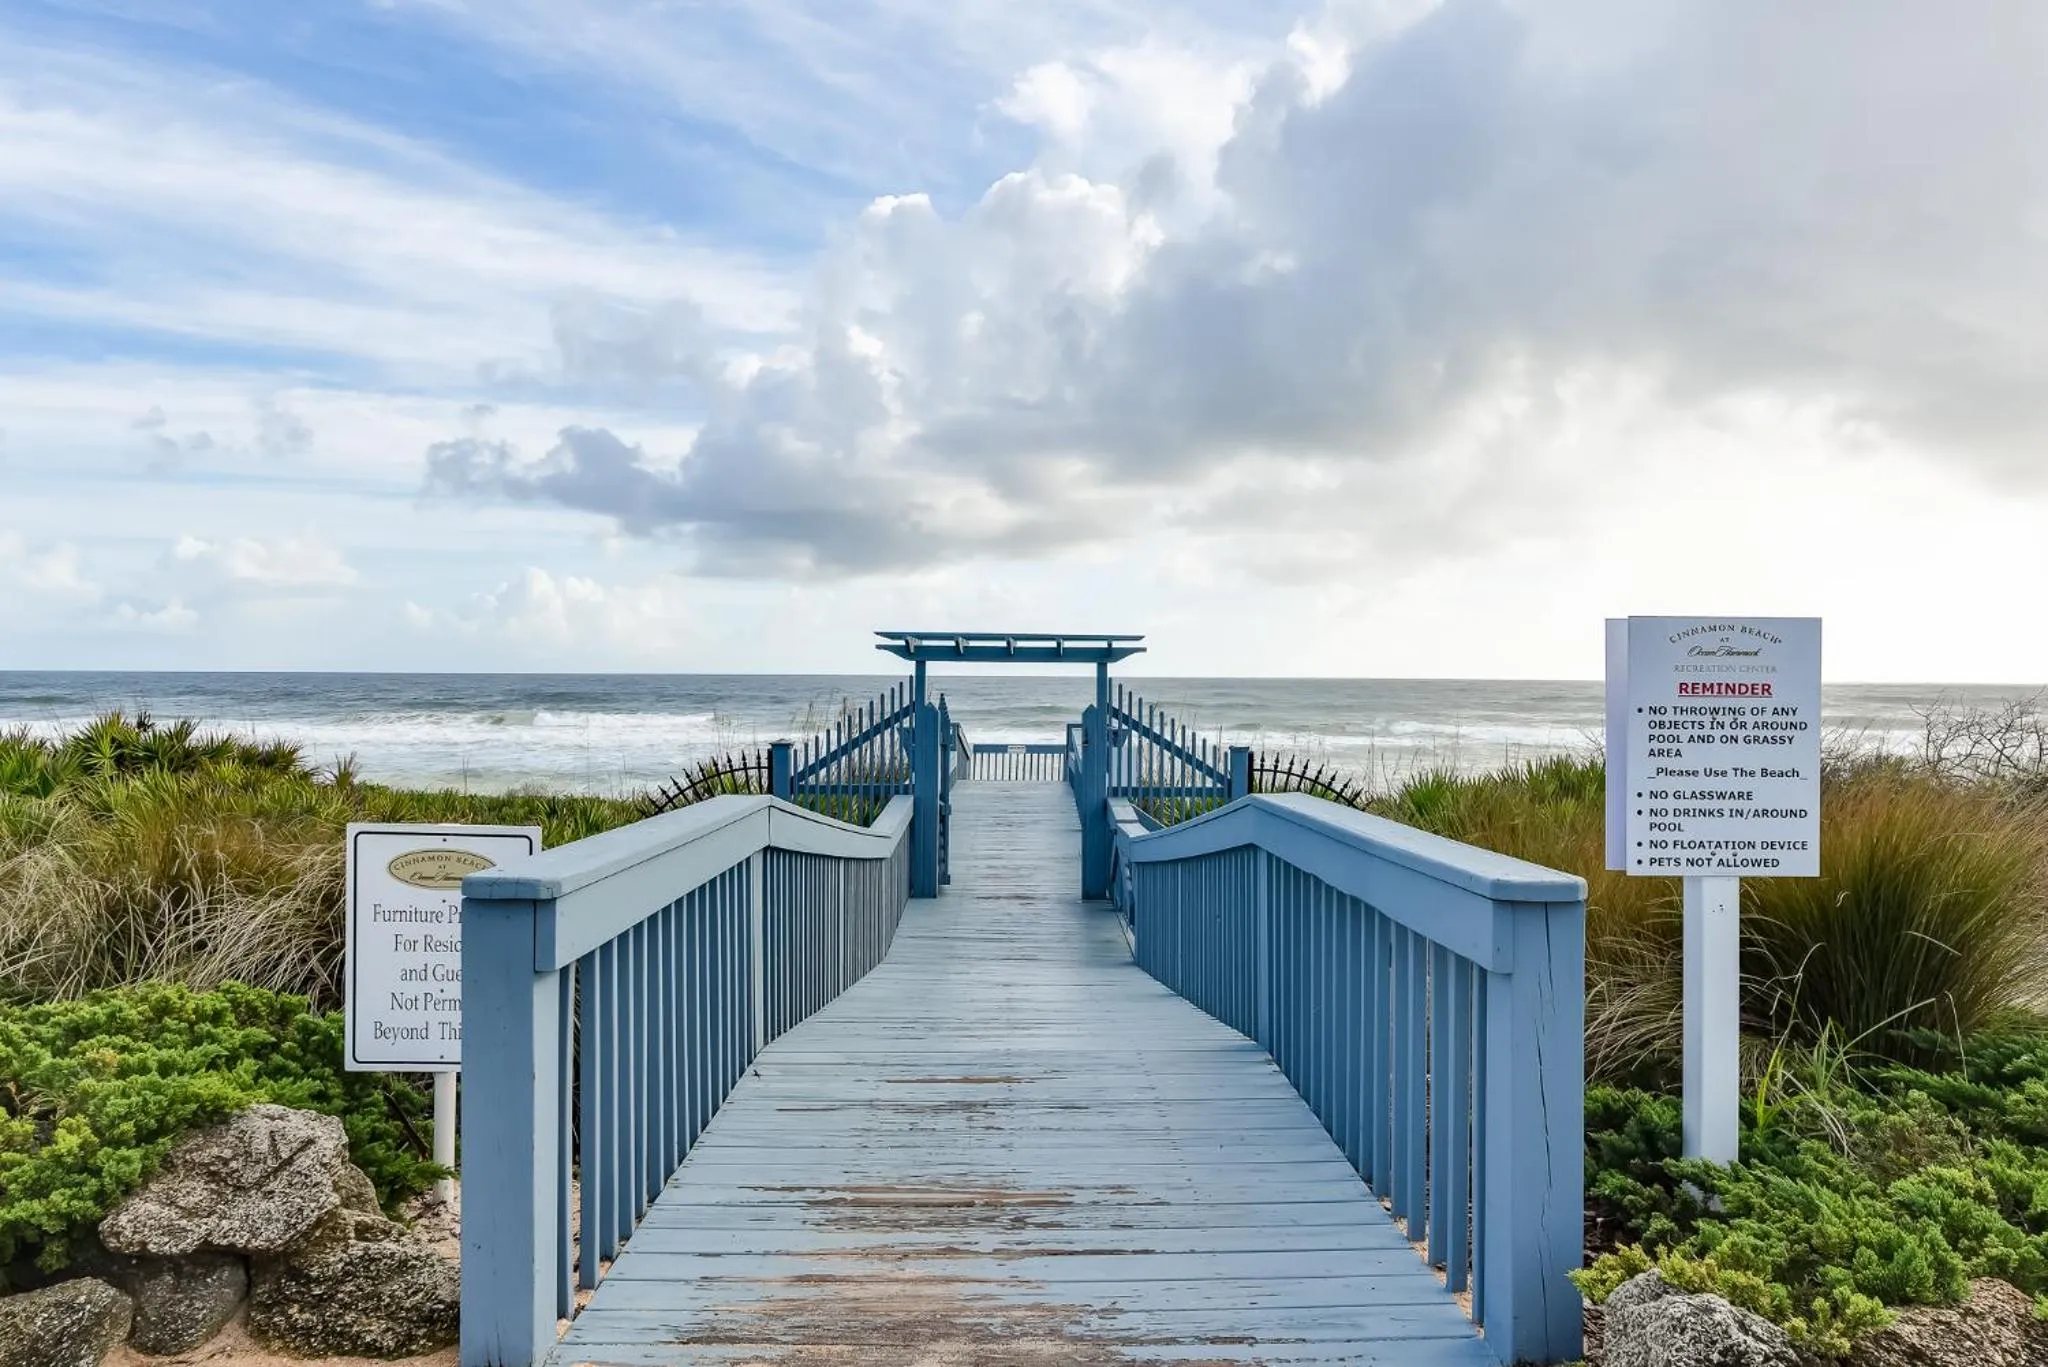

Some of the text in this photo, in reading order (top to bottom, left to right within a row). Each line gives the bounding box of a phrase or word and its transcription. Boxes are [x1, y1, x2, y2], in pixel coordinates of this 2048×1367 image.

[1669, 624, 1735, 643] CINNAMON
[1673, 664, 1777, 673] RECREATION CENTER
[1678, 682, 1773, 697] REMINDER
[1648, 705, 1799, 717] NO THROWING OF ANY
[1648, 720, 1808, 731] OBJECTS IN OR AROUND
[1648, 734, 1795, 745] POOL AND ON GRASSY
[1648, 748, 1683, 758] AREA
[1703, 767, 1728, 778] Use
[1732, 767, 1756, 778] The
[1649, 790, 1754, 801] NO GLASSWARE
[1649, 807, 1808, 819] NO DRINKS IN/AROUND
[1649, 822, 1684, 832] POOL
[1649, 839, 1808, 851] NO FLOATATION DEVICE
[393, 855, 451, 870] CINNAMON
[1649, 857, 1780, 868] PETS NOT ALLOWED
[373, 903, 444, 924] Furniture
[393, 933, 419, 952] For
[400, 963, 428, 981] and
[390, 992, 419, 1011] Not
[373, 1020, 429, 1046] Beyond
